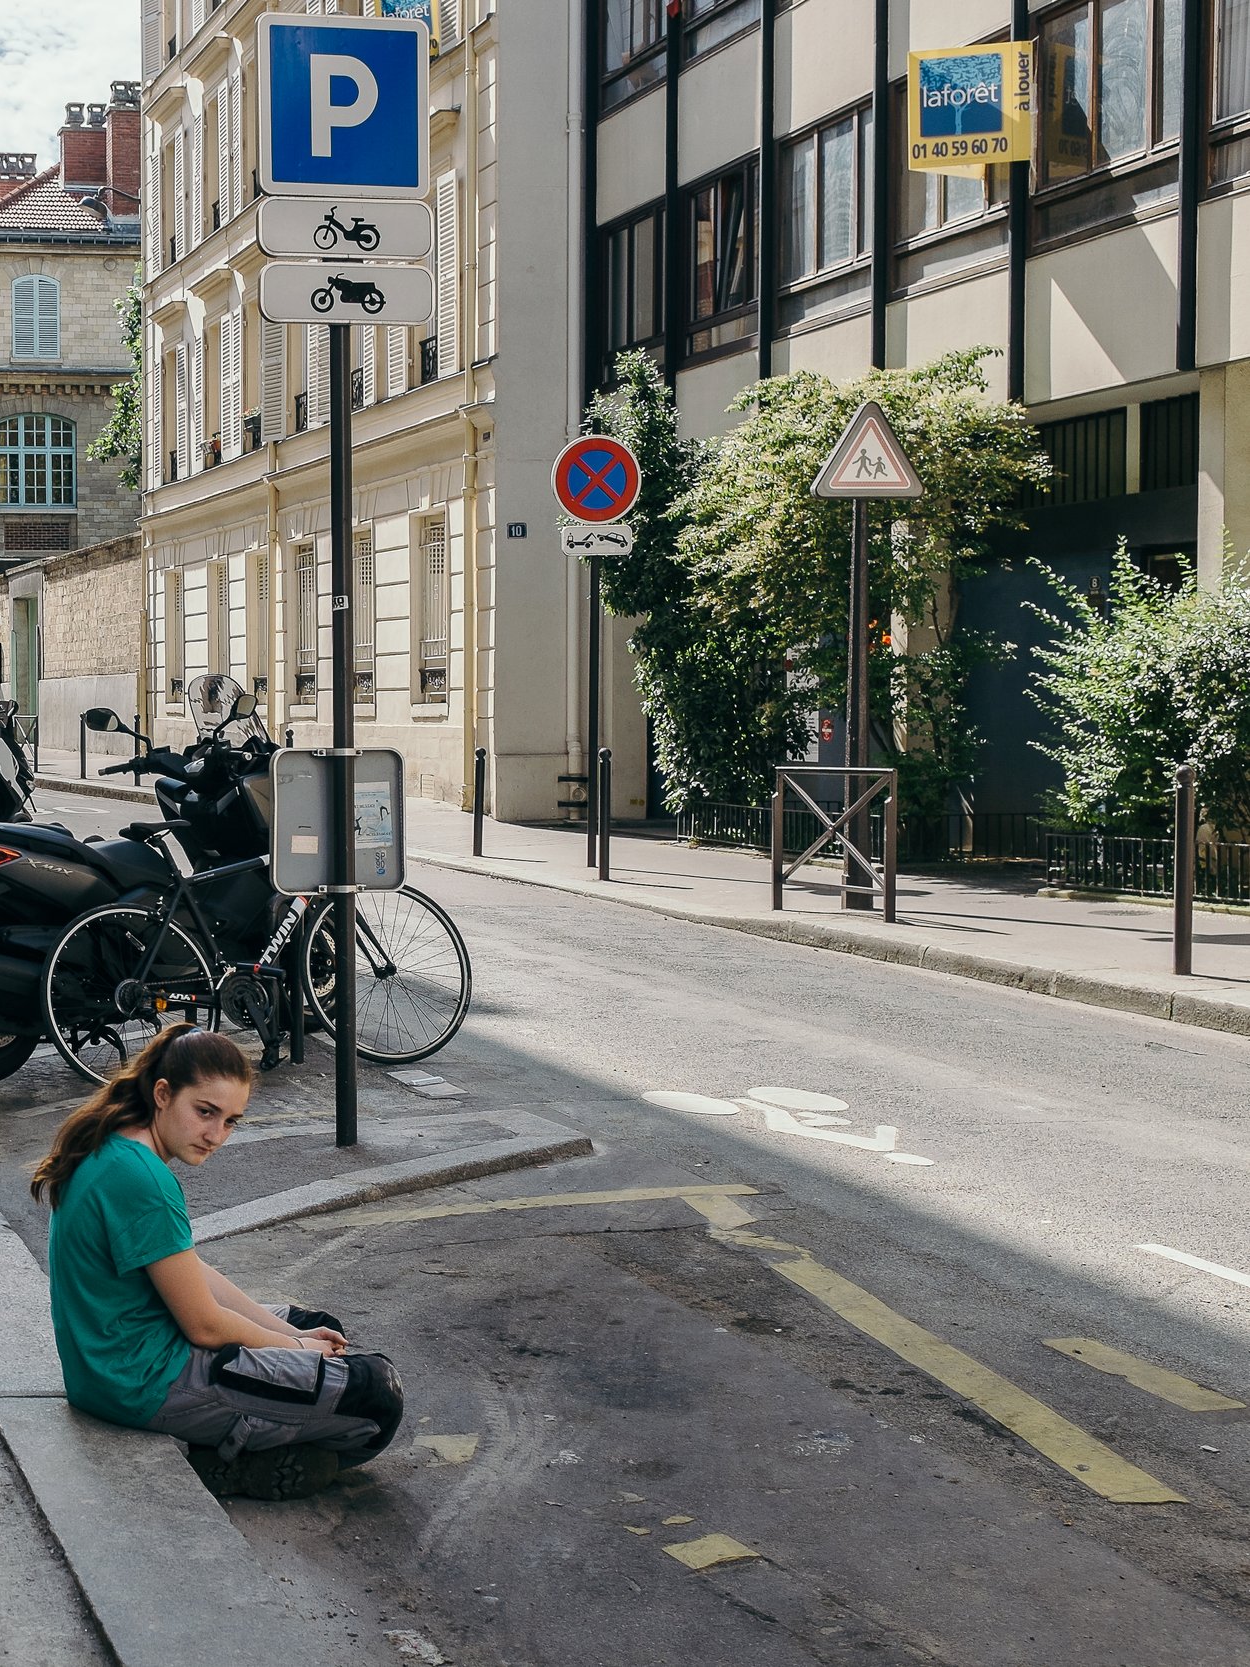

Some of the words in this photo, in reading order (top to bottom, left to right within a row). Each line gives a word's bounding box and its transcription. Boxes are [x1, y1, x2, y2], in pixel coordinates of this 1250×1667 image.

[1014, 52, 1030, 97] louer
[310, 54, 379, 157] P
[923, 81, 999, 108] laforêt
[1014, 101, 1030, 112] à
[912, 144, 927, 159] 01
[931, 141, 949, 157] 40
[951, 139, 968, 156] 59
[971, 139, 988, 154] 60
[992, 137, 1008, 153] 70
[511, 526, 523, 537] 10
[1091, 578, 1098, 588] 8
